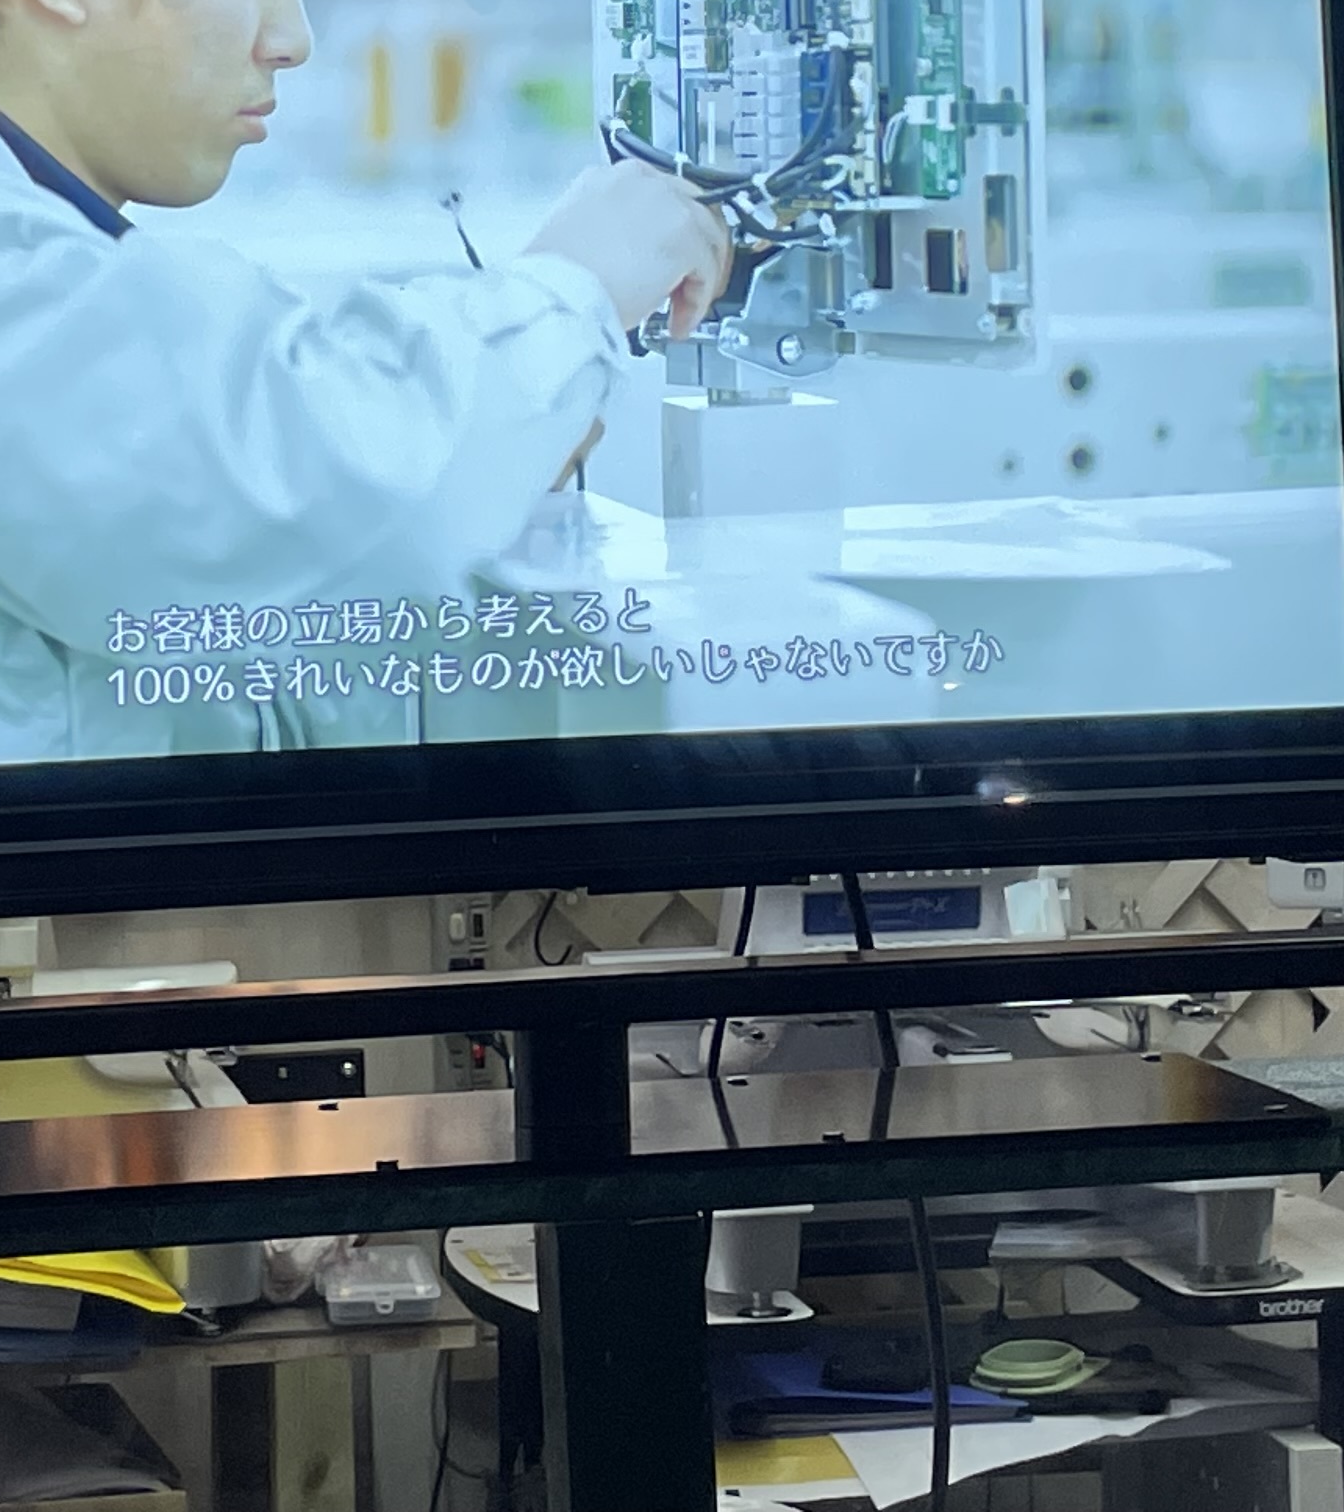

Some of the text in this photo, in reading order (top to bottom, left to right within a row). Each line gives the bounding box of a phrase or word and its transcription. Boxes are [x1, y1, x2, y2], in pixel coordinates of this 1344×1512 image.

[106, 587, 652, 654] お客様の立場から考えると
[107, 628, 1005, 706] 100%きれいなものが欲しいじゃないですか
[1259, 1298, 1325, 1317] brother
